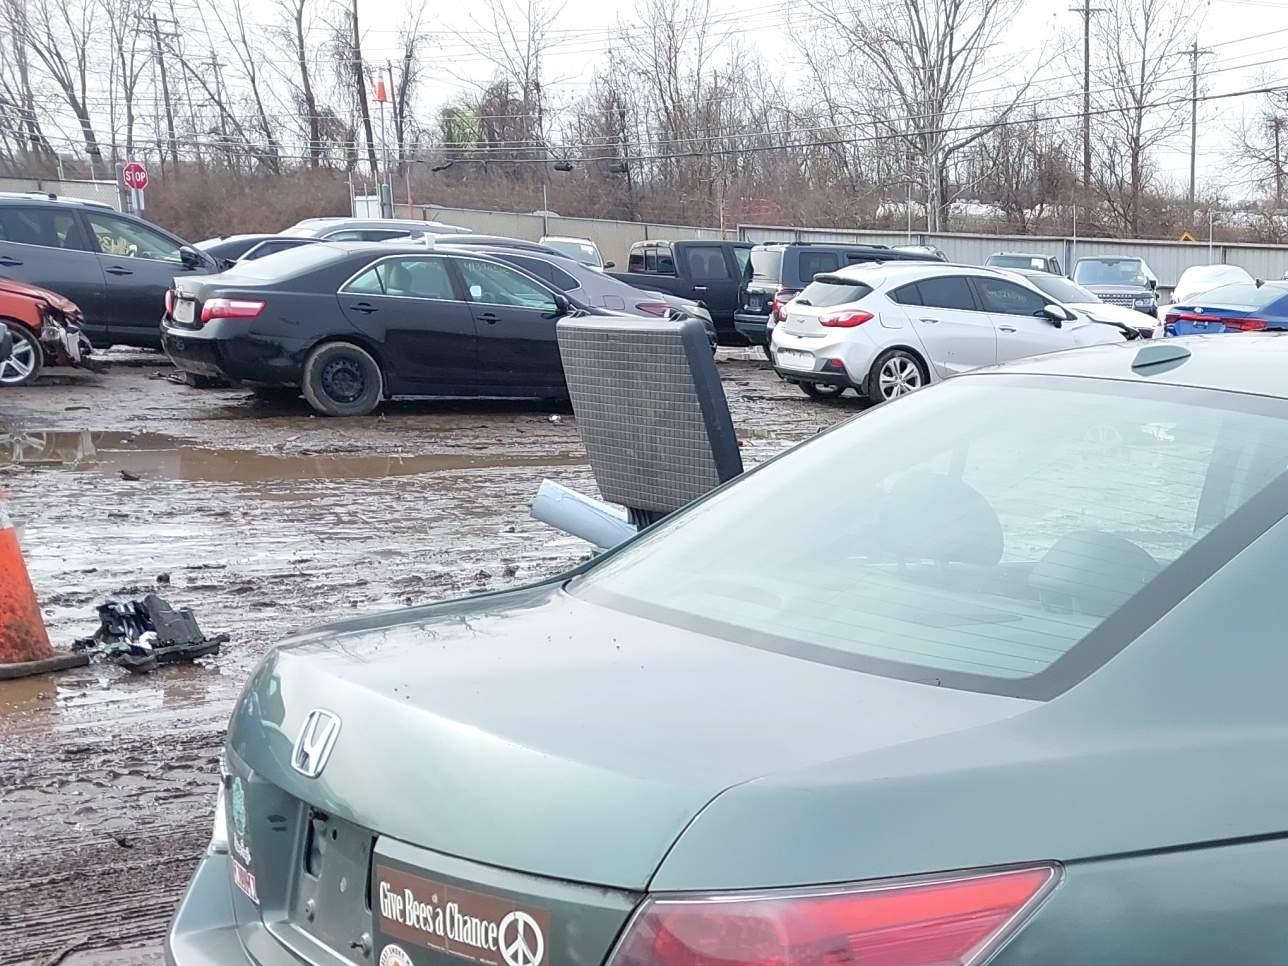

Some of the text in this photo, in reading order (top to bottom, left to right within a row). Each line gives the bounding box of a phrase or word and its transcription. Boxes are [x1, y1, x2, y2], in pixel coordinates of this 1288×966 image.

[126, 170, 146, 182] STOP
[379, 881, 404, 924] Give
[404, 888, 434, 933] Bees
[435, 907, 445, 936] a
[446, 902, 498, 951] Chance
